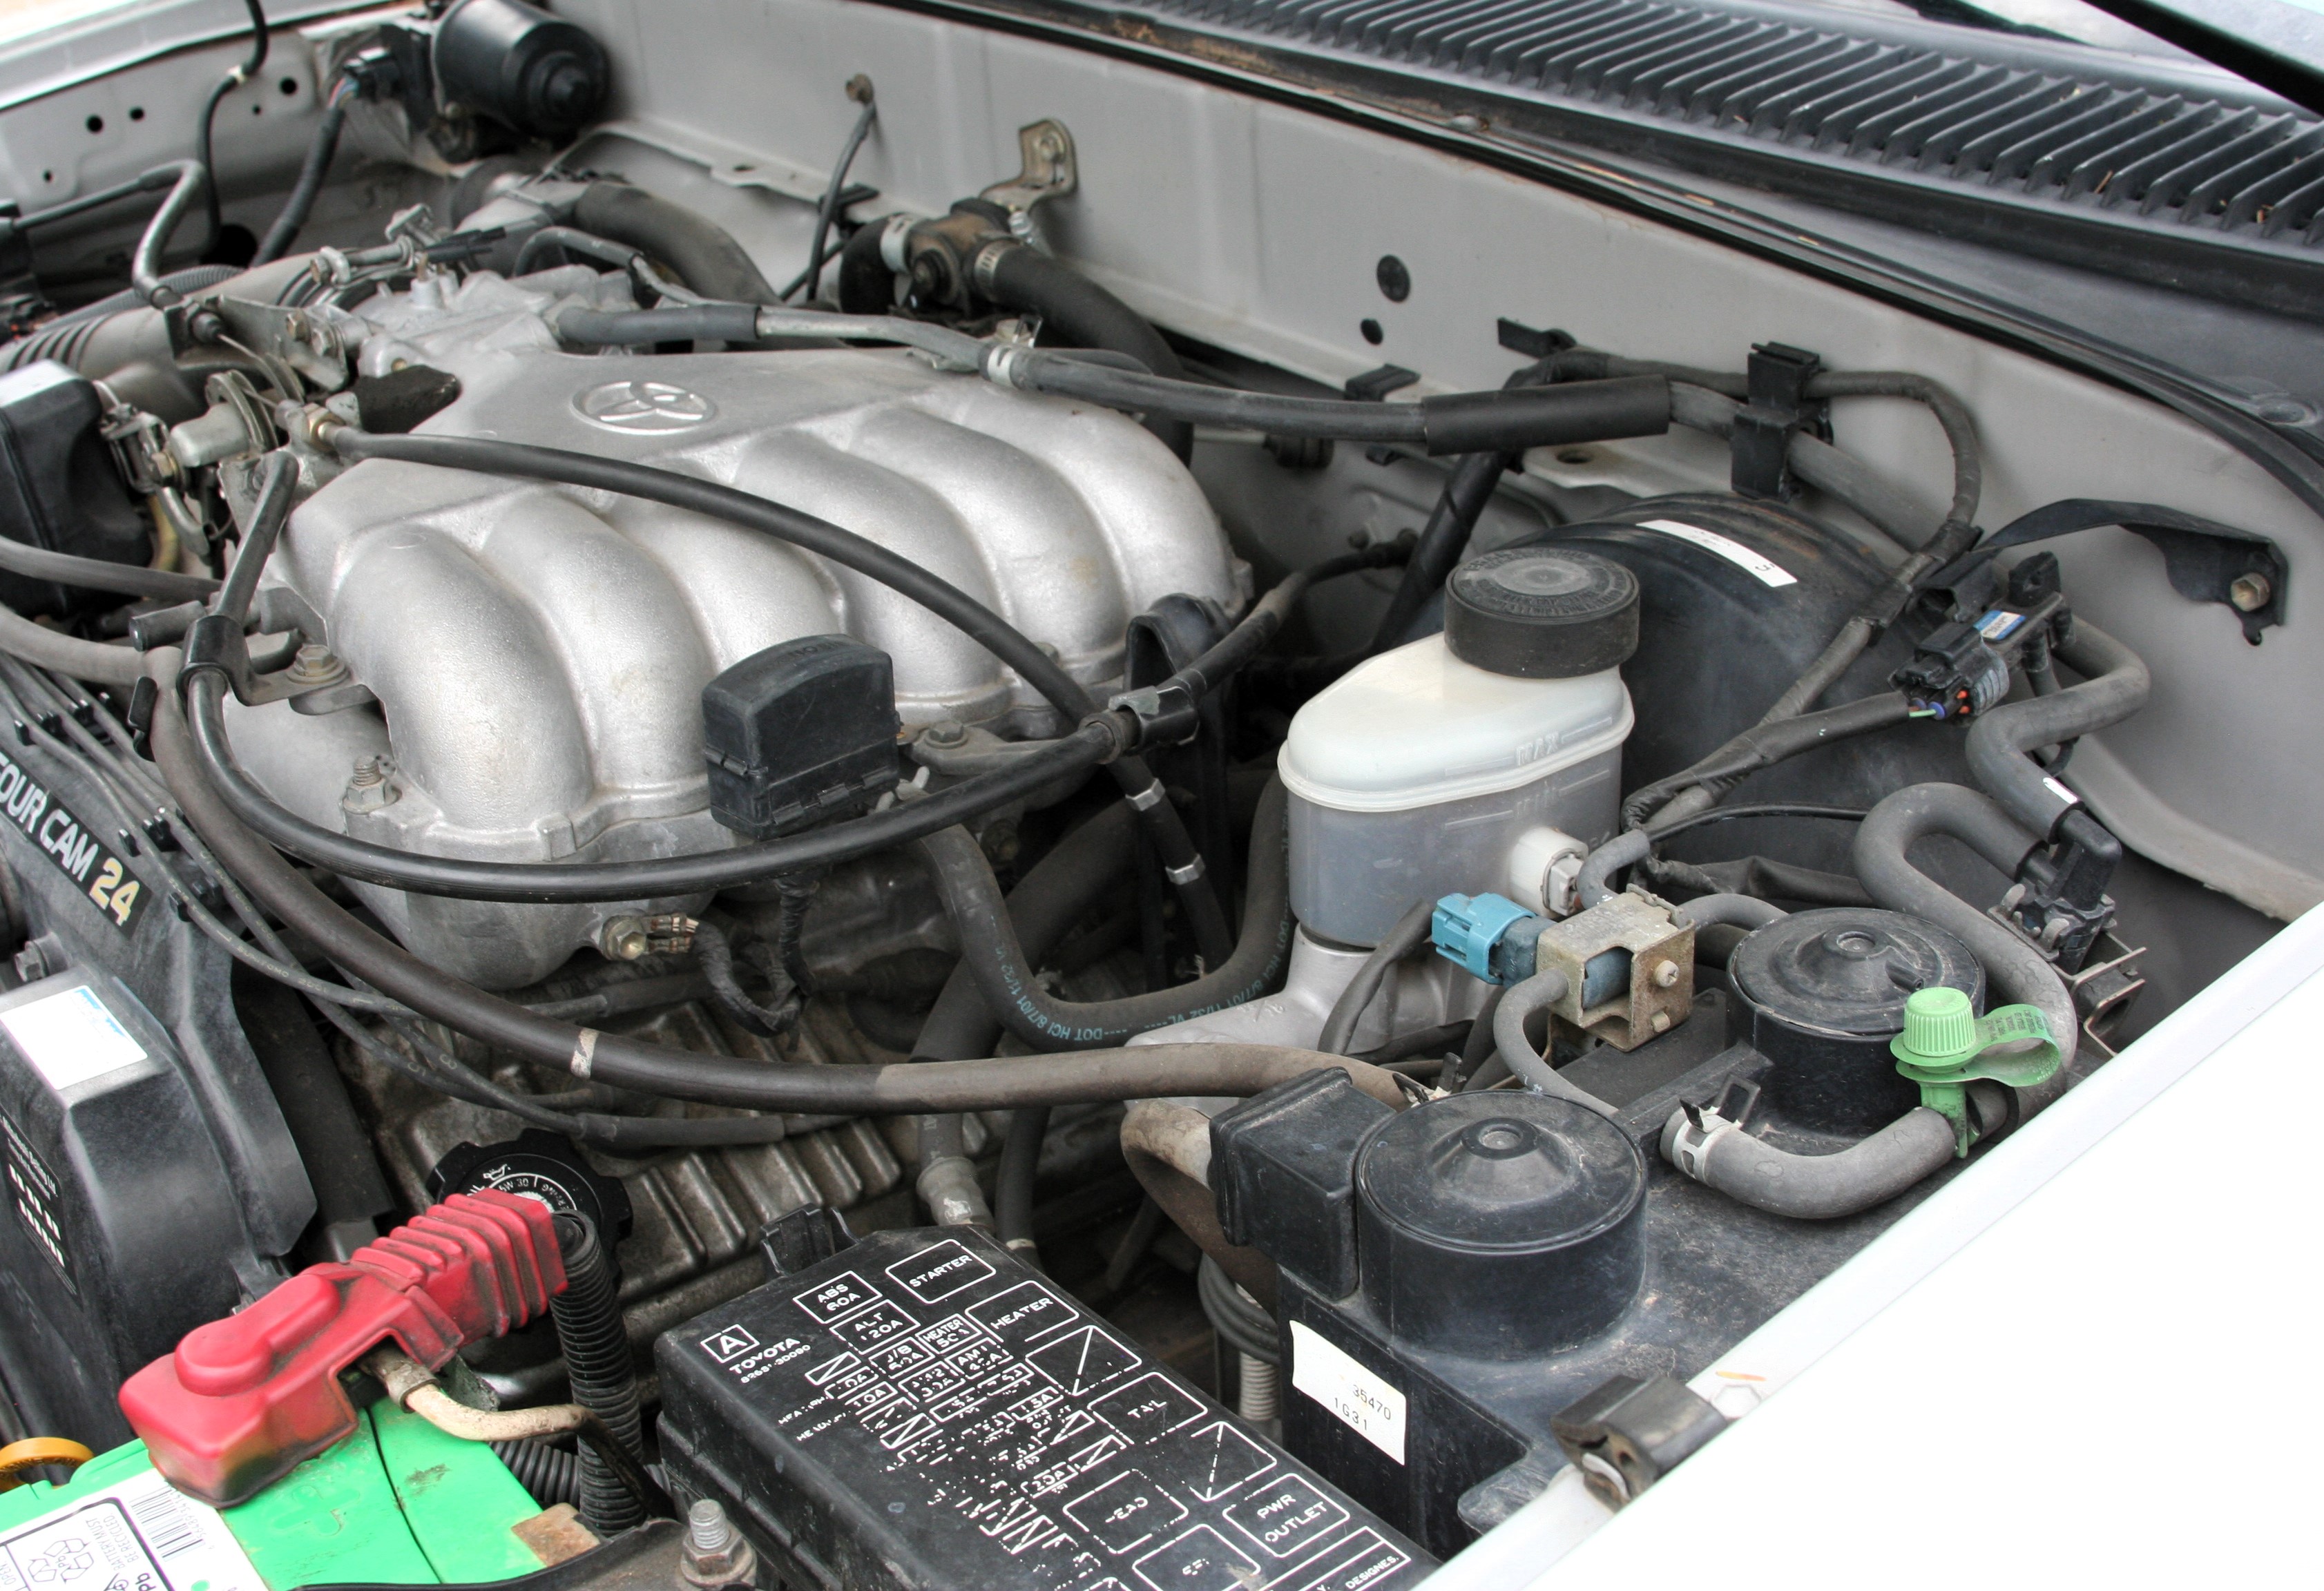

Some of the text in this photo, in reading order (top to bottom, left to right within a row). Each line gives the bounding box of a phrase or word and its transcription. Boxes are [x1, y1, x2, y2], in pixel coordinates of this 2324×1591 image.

[40, 809, 99, 883] CAM
[89, 857, 140, 926] 24
[1074, 1027, 1104, 1041] DOT
[908, 1254, 974, 1287] STARTER
[817, 1283, 849, 1304] ABS
[826, 1292, 862, 1311] 60A
[854, 1312, 884, 1332] ALT
[989, 1297, 1055, 1330] HEATER
[860, 1319, 904, 1341] 120A
[922, 1319, 965, 1343] HEATER
[719, 1334, 749, 1355] A
[729, 1338, 801, 1374] TOYOTA
[887, 1344, 913, 1363] J/B
[1334, 1397, 1368, 1431] 1G31
[1352, 1384, 1392, 1421] 35470
[1256, 1494, 1297, 1519] PWR
[1264, 1501, 1329, 1543] OUTLET
[85, 1518, 126, 1572] BATTERY MUST
[124, 1551, 140, 1563] BE
[135, 1572, 157, 1591] Pb
